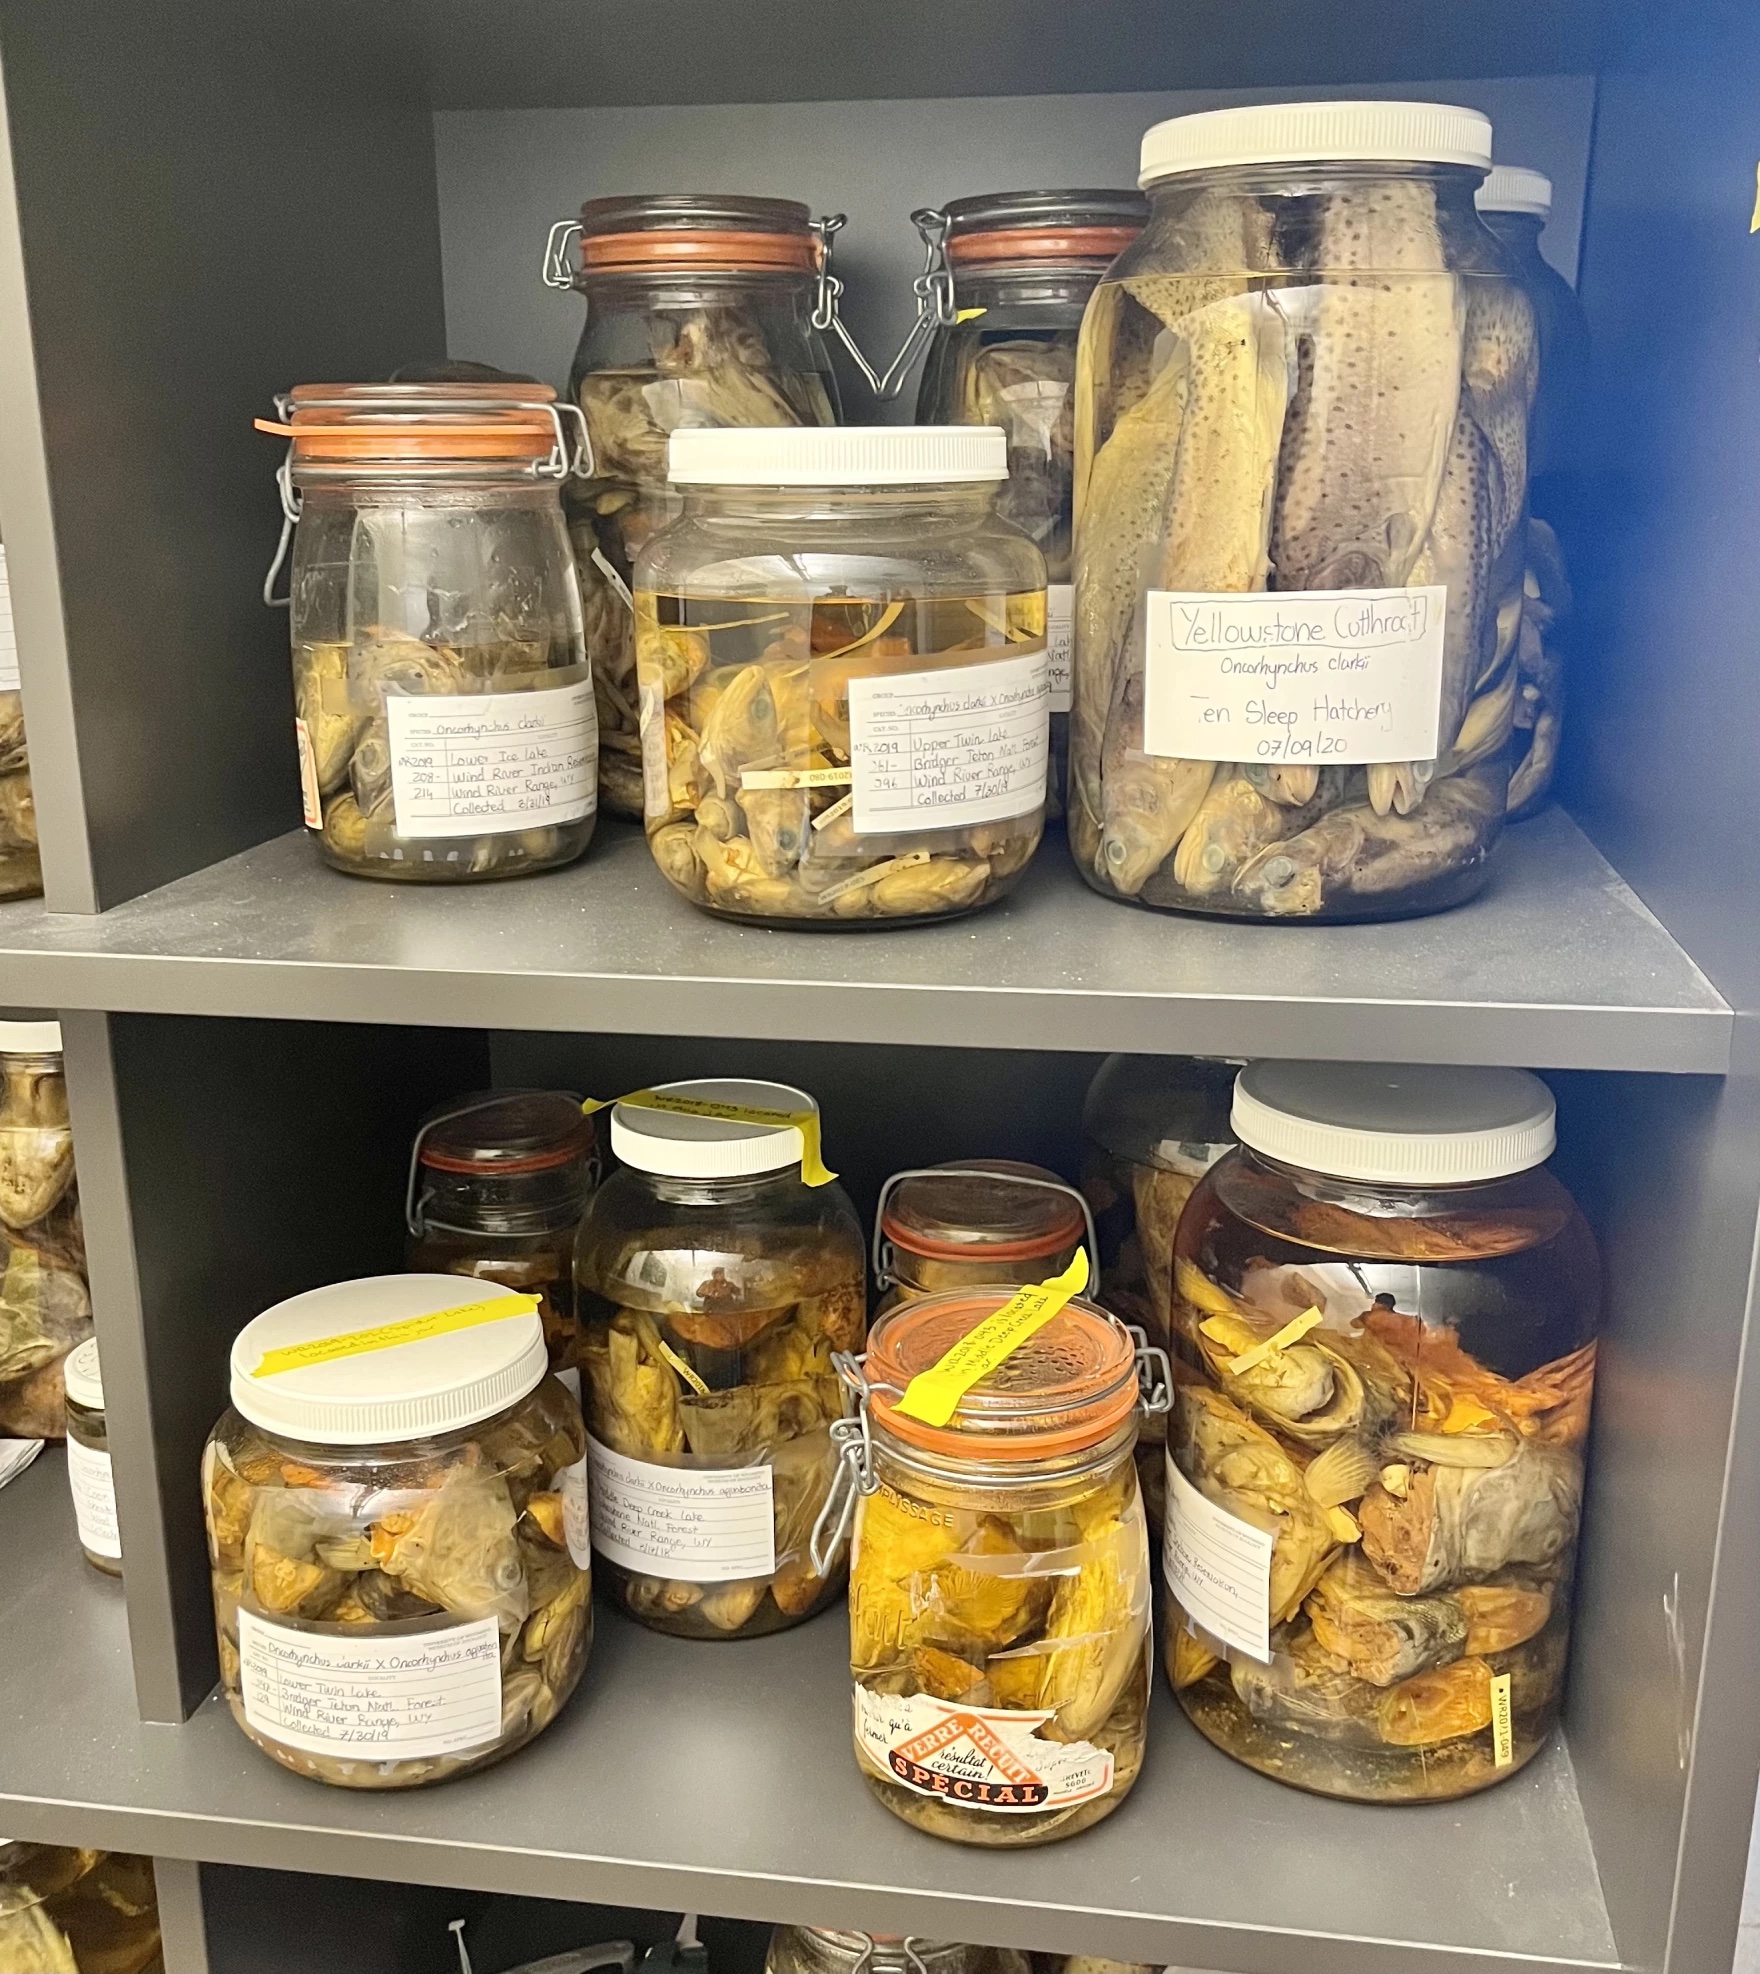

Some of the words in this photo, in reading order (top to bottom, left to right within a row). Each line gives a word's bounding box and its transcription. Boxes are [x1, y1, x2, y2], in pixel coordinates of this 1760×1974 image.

[1179, 606, 1326, 645] Yellowstone
[1333, 603, 1421, 638] Cutthroat
[1220, 652, 1319, 690] Oncorhynchus
[1328, 652, 1372, 671] clarkii
[899, 701, 960, 721] ncorhynchus
[1245, 699, 1298, 732] Sleep
[1312, 694, 1393, 732] Hatchery
[913, 737, 951, 759] Upper
[953, 733, 984, 747] Twin
[988, 727, 1010, 743] Lake
[1256, 731, 1348, 759] 07/09/20
[451, 752, 488, 767] Lower
[498, 750, 519, 763] Ice
[525, 747, 548, 761] Lake
[914, 755, 960, 774] Bridger
[967, 749, 995, 765] Teton
[453, 766, 485, 783] Wind
[492, 767, 524, 779] River
[530, 760, 565, 776] Indian
[913, 771, 946, 788] Wind
[953, 766, 984, 782] River
[413, 787, 433, 800] 214
[451, 784, 482, 799] Wind
[486, 783, 518, 797] River
[525, 778, 558, 797] Range,
[917, 784, 967, 806] Collected
[974, 779, 1009, 800] 7/30/19
[453, 800, 505, 815] Collected
[656, 1482, 715, 1498] Oncorhynchus
[623, 1498, 643, 1515] Deep
[680, 1512, 705, 1522] Lake
[650, 1530, 687, 1549] Range,
[666, 1522, 699, 1534] Forest
[268, 1642, 331, 1668] Oncorhynchus
[335, 1655, 370, 1670] carkii
[376, 1659, 385, 1670] X
[389, 1650, 461, 1673] Oncorhynchus
[279, 1673, 311, 1691] Lower
[316, 1681, 345, 1698] Twin
[351, 1686, 382, 1698] Lake
[282, 1702, 310, 1721] Wind
[316, 1710, 349, 1725] River
[358, 1714, 399, 1732] Range,
[408, 1713, 432, 1724] WY
[283, 1716, 330, 1738] Collected
[901, 1717, 965, 1761] VERRE
[968, 1721, 1035, 1784] RECUIT
[939, 1745, 986, 1769] résultat
[895, 1757, 1040, 1804] SPÉCIAL
